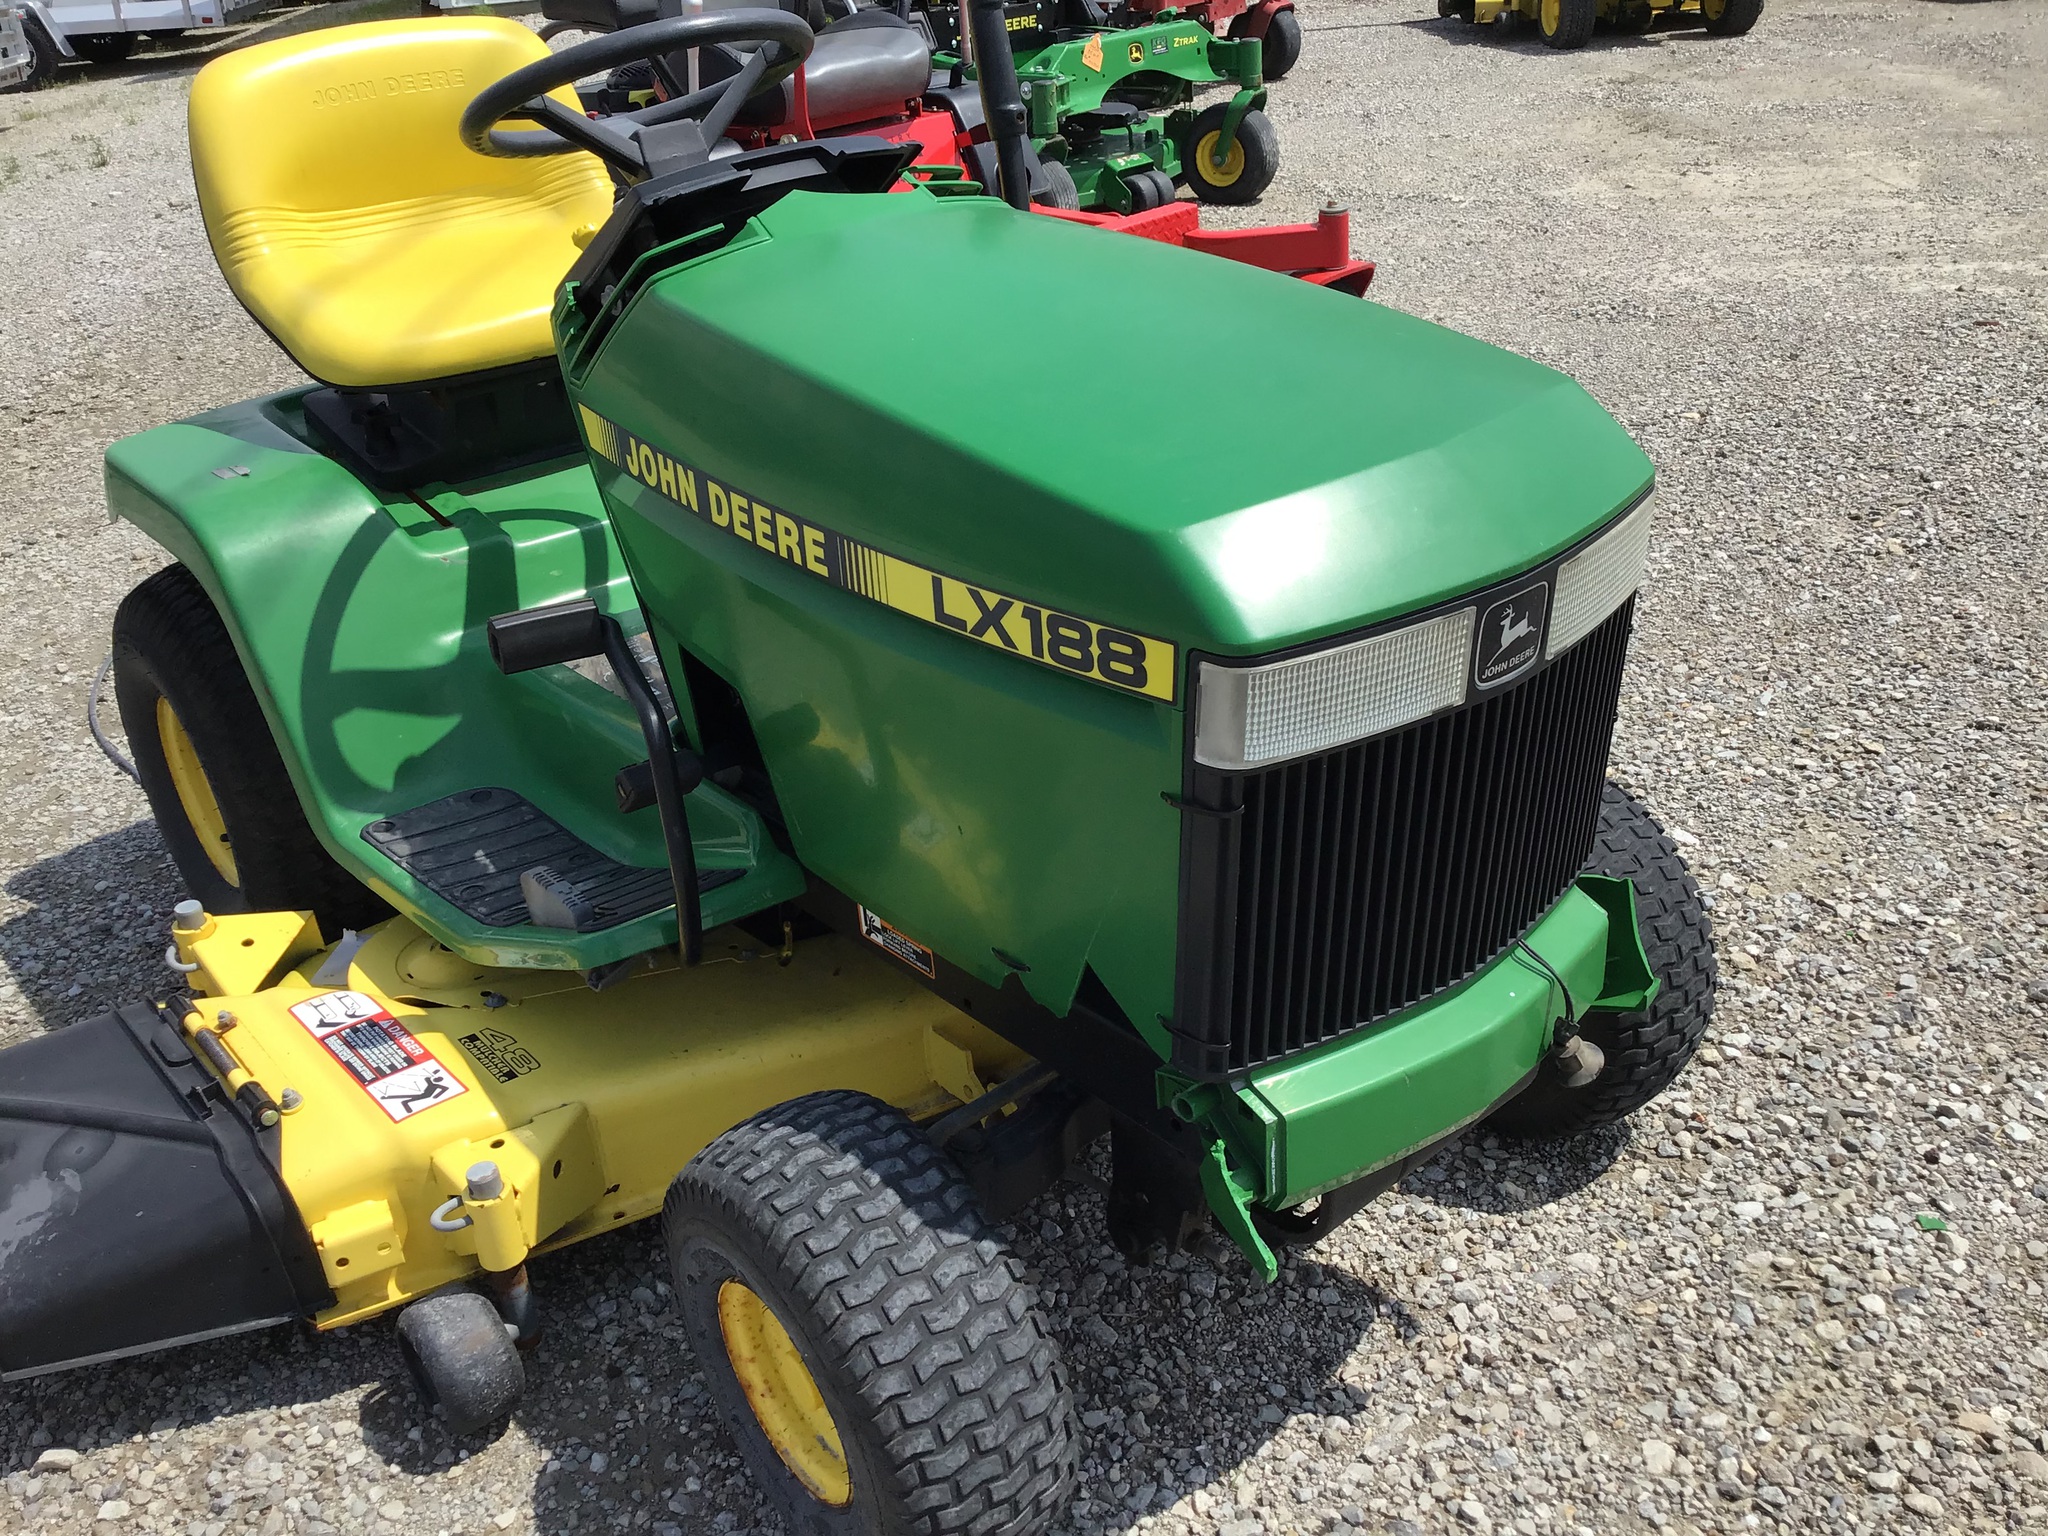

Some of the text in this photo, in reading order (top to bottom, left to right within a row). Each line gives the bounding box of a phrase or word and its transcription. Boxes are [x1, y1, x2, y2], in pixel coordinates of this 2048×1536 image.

[1005, 15, 1037, 31] EERE
[312, 68, 465, 110] JOHN DEERE
[625, 436, 829, 577] JOHN DEERE
[931, 575, 1148, 689] LX188
[1482, 645, 1536, 679] JOHN DEERE
[387, 1025, 425, 1057] DANGER
[460, 1038, 509, 1082] COMPATIBLE
[473, 1040, 511, 1073] MULCHER
[479, 1027, 541, 1076] 48
